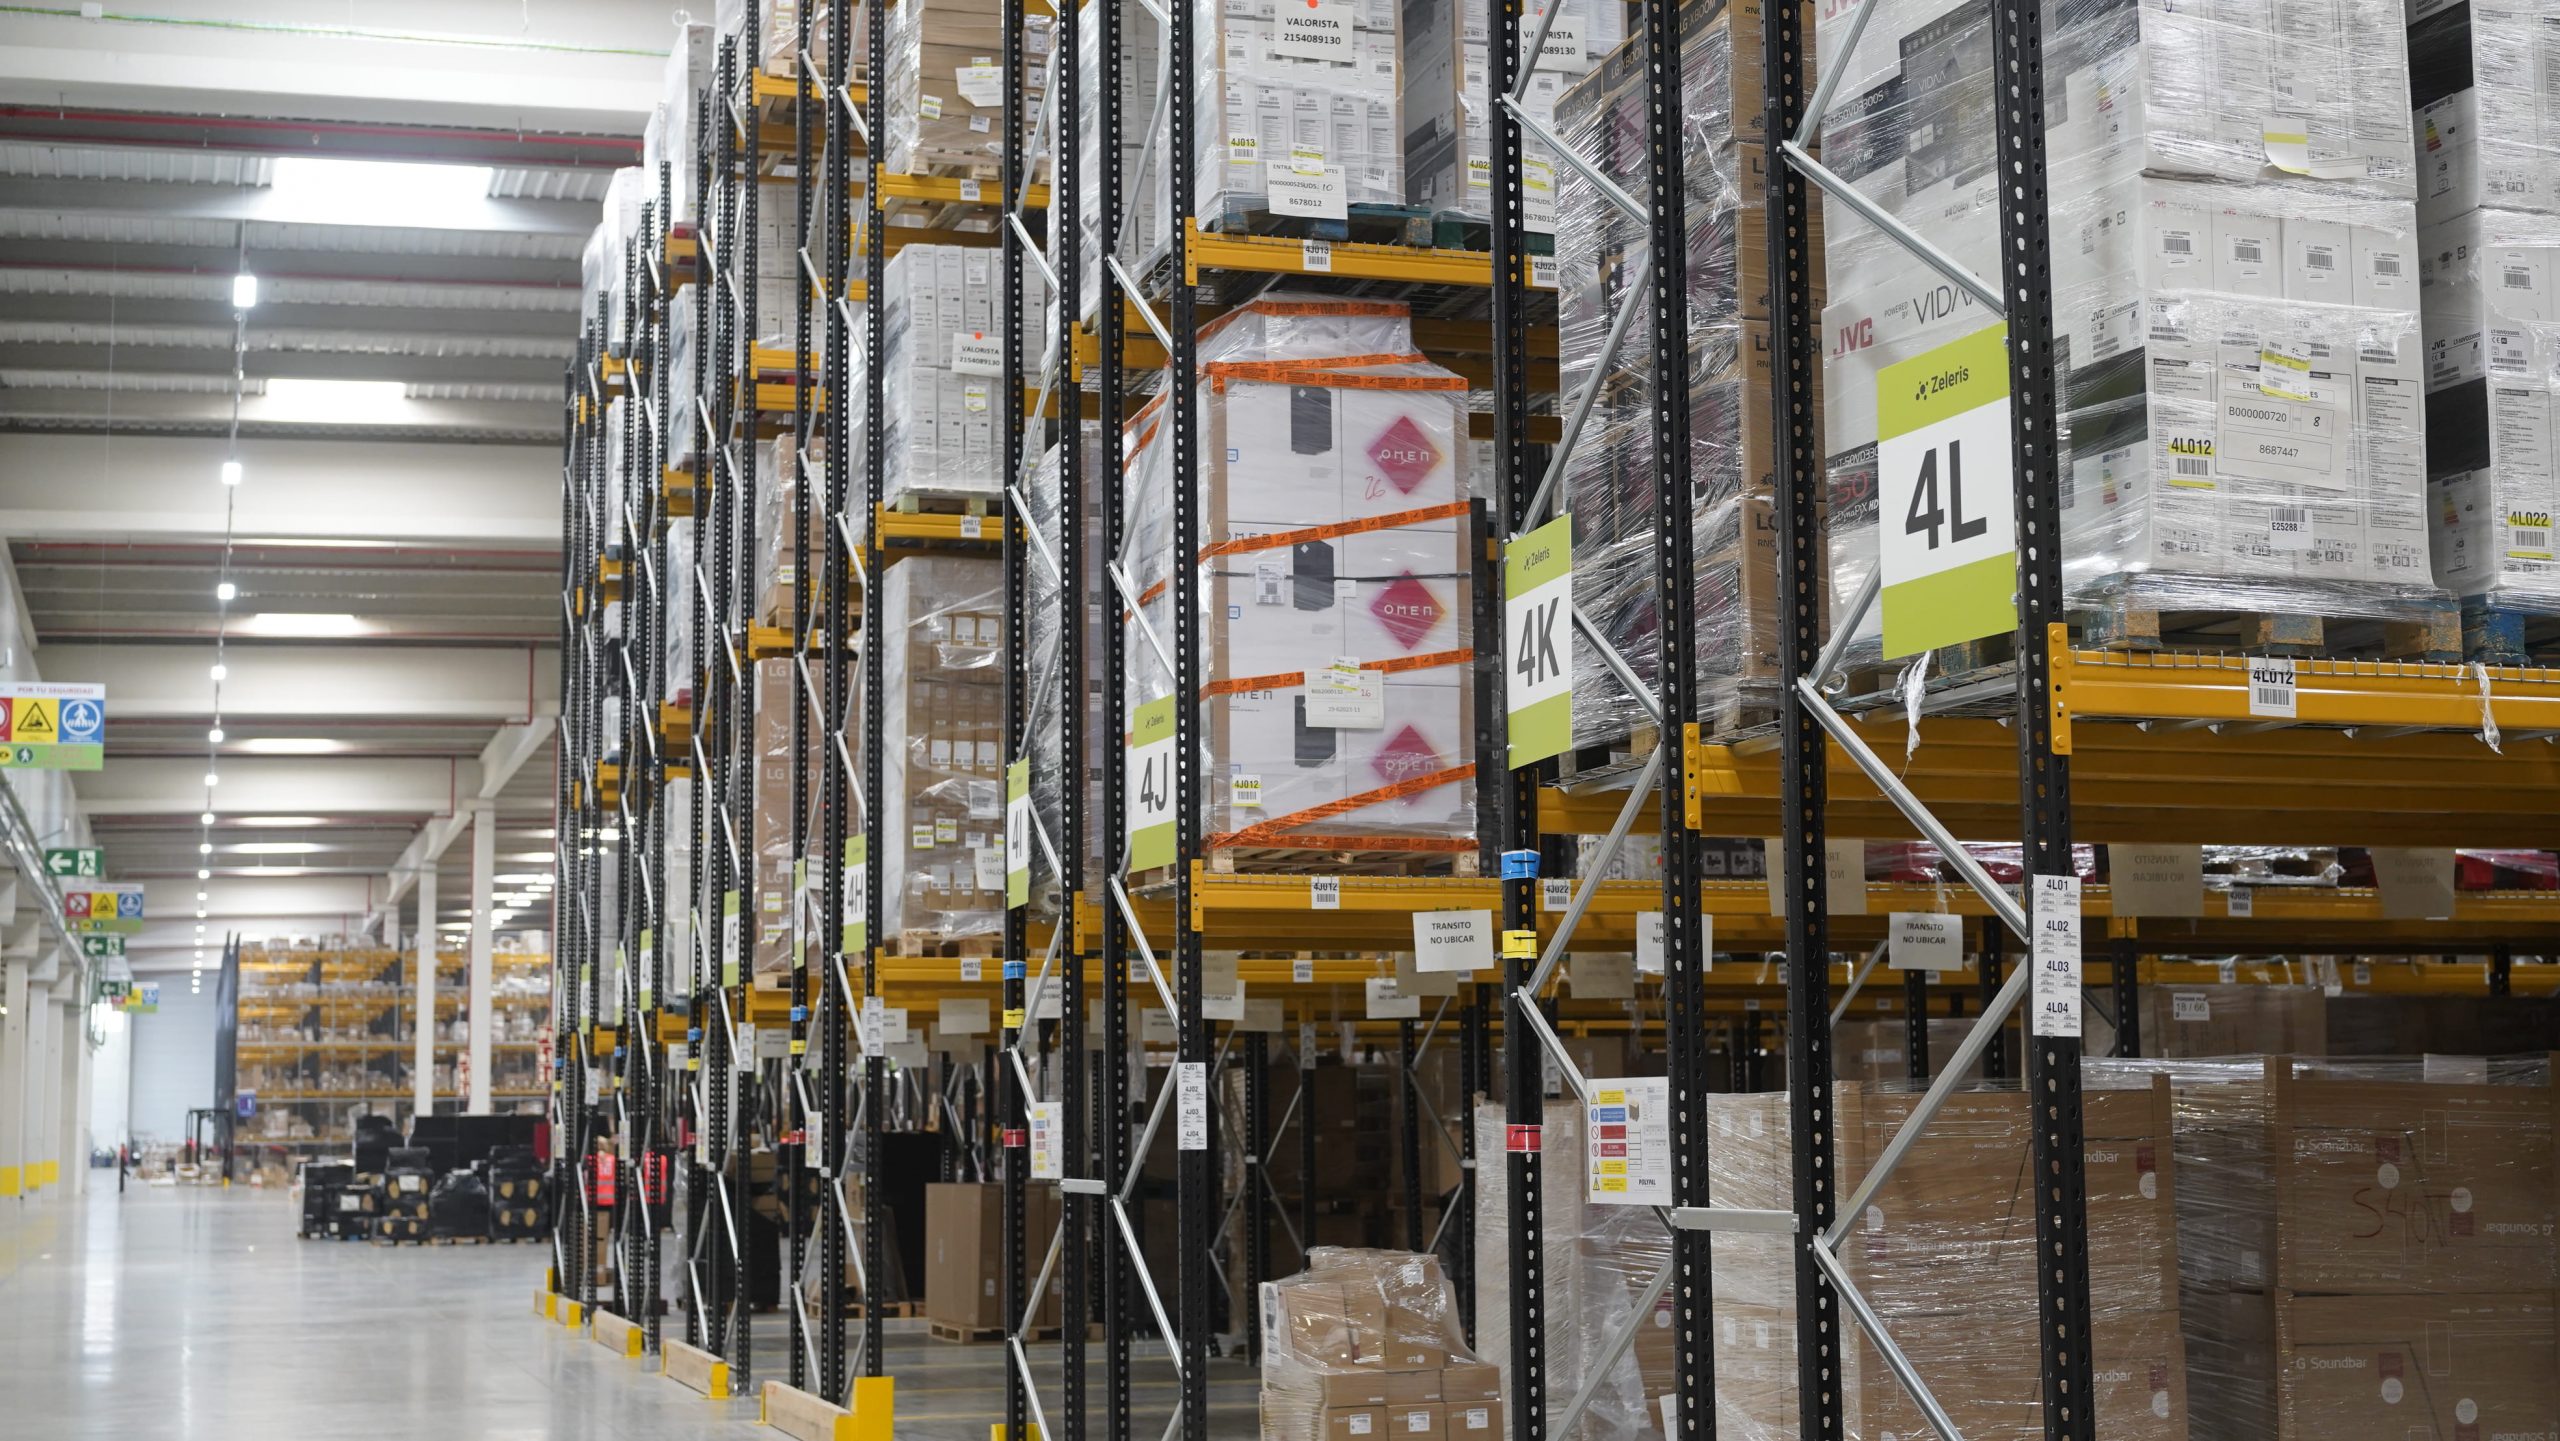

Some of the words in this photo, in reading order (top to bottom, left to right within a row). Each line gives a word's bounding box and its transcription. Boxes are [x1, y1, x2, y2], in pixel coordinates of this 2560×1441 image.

[1745, 6, 1761, 15] RNC
[1286, 17, 1340, 29] VALORISTA
[1283, 33, 1341, 45] 2154089130
[1230, 138, 1256, 147] 4J013
[1470, 160, 1490, 169] 4J02
[1322, 183, 1334, 192] 10
[1289, 197, 1322, 207] 8678012
[1524, 213, 1555, 223] 8678012
[1304, 245, 1331, 256] 4J013
[1534, 261, 1557, 271] 4J023
[1913, 276, 1980, 325] VIDA
[1901, 310, 1909, 320] BY
[2091, 309, 2105, 322] JVC
[1834, 316, 1873, 359] JVC
[961, 344, 1000, 355] VALORISTA
[2431, 339, 2446, 351] JVC
[959, 356, 1000, 366] 2154089130
[1931, 365, 1969, 395] Zeleris
[2228, 405, 2287, 423] B000000720
[2170, 437, 2212, 455] 4L012
[2259, 443, 2299, 459] 8687447
[1380, 449, 1430, 463] OMEN
[1836, 471, 1869, 505] 50
[1905, 439, 1987, 551] 4L
[2510, 511, 2549, 527] 4L022
[2271, 521, 2299, 532] E25288
[1530, 548, 1550, 567] Zeleris
[1384, 603, 1433, 617] OMEN
[1516, 596, 1561, 688] 4K
[2252, 667, 2294, 686] 4L012
[1385, 758, 1435, 772] OMEN
[1139, 751, 1169, 814] 4J
[1235, 779, 1259, 789] 4J012
[984, 868, 1004, 876] VALO
[1313, 882, 1338, 892] 4J012
[1545, 884, 1569, 894] 4J022
[2046, 878, 2069, 891] 4L01
[847, 871, 864, 915] 4H
[1431, 921, 1471, 931] TRANSITO
[1906, 922, 1944, 932] TRANSITO
[2046, 920, 2069, 932] 4L02
[1430, 936, 1443, 945] NO
[1444, 934, 1475, 944] UBICAR
[1902, 936, 1914, 944] NO
[1915, 936, 1946, 945] UBICAR
[2046, 960, 2069, 972] 4L03
[2046, 1002, 2069, 1013] 4L04
[1185, 1130, 1199, 1138] 4J04
[2308, 1137, 2365, 1153] Soundbar
[2084, 1150, 2119, 1163] ndbar
[2483, 1222, 2538, 1235] Soundbar
[2310, 1355, 2367, 1370] Soundbar
[2093, 1371, 2132, 1384] ndbar
